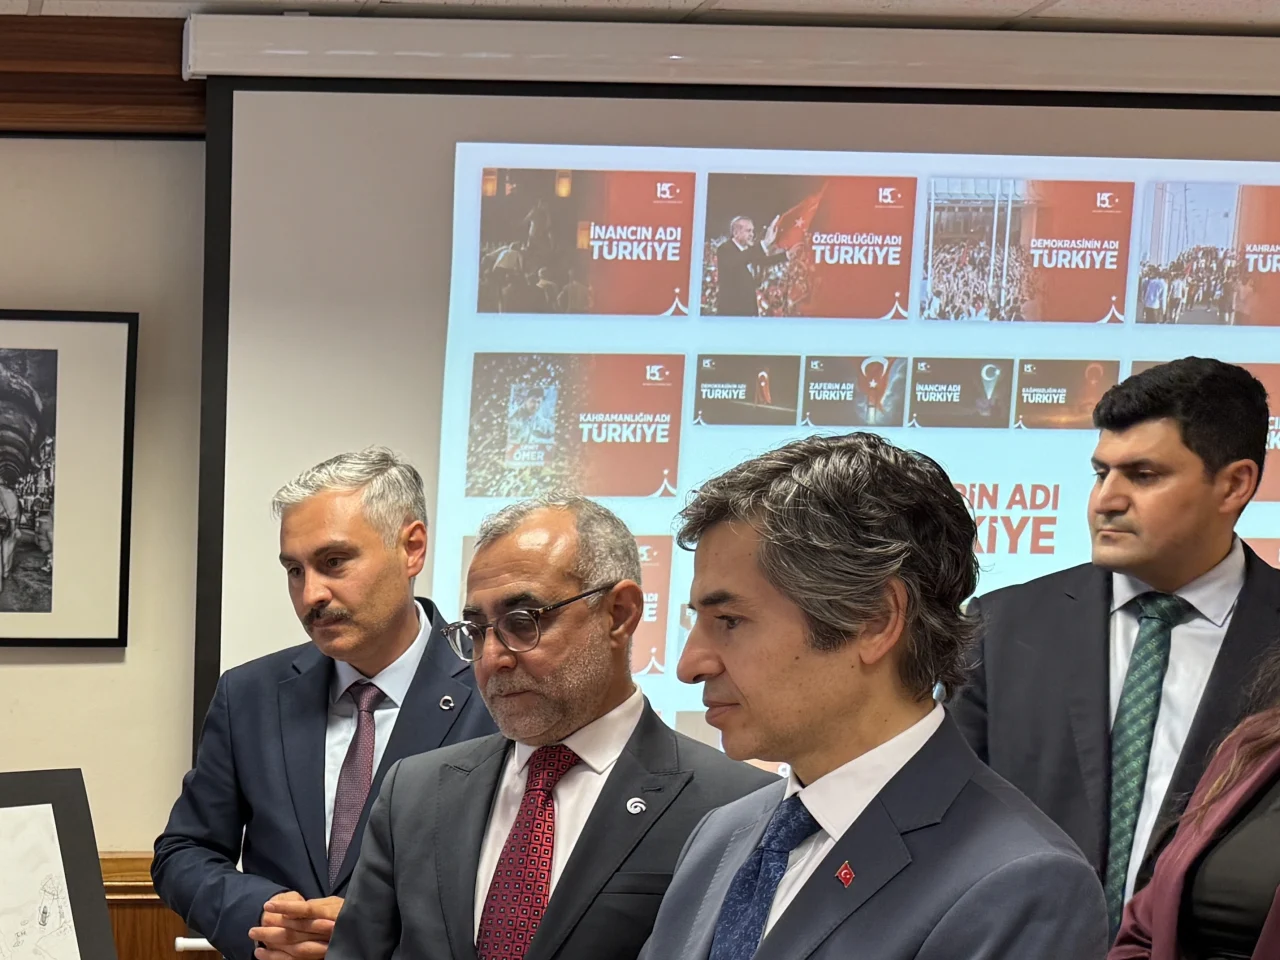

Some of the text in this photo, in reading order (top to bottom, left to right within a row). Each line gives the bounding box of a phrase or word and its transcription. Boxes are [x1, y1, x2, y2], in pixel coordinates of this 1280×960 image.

[589, 222, 681, 241] İNANCIN ADI
[812, 232, 902, 245] ÖZGÜRLÜĞÜN ADI
[1030, 238, 1119, 250] DEMOKRASİNİN ADI
[654, 413, 671, 423] ADI
[1005, 483, 1060, 511] ADI
